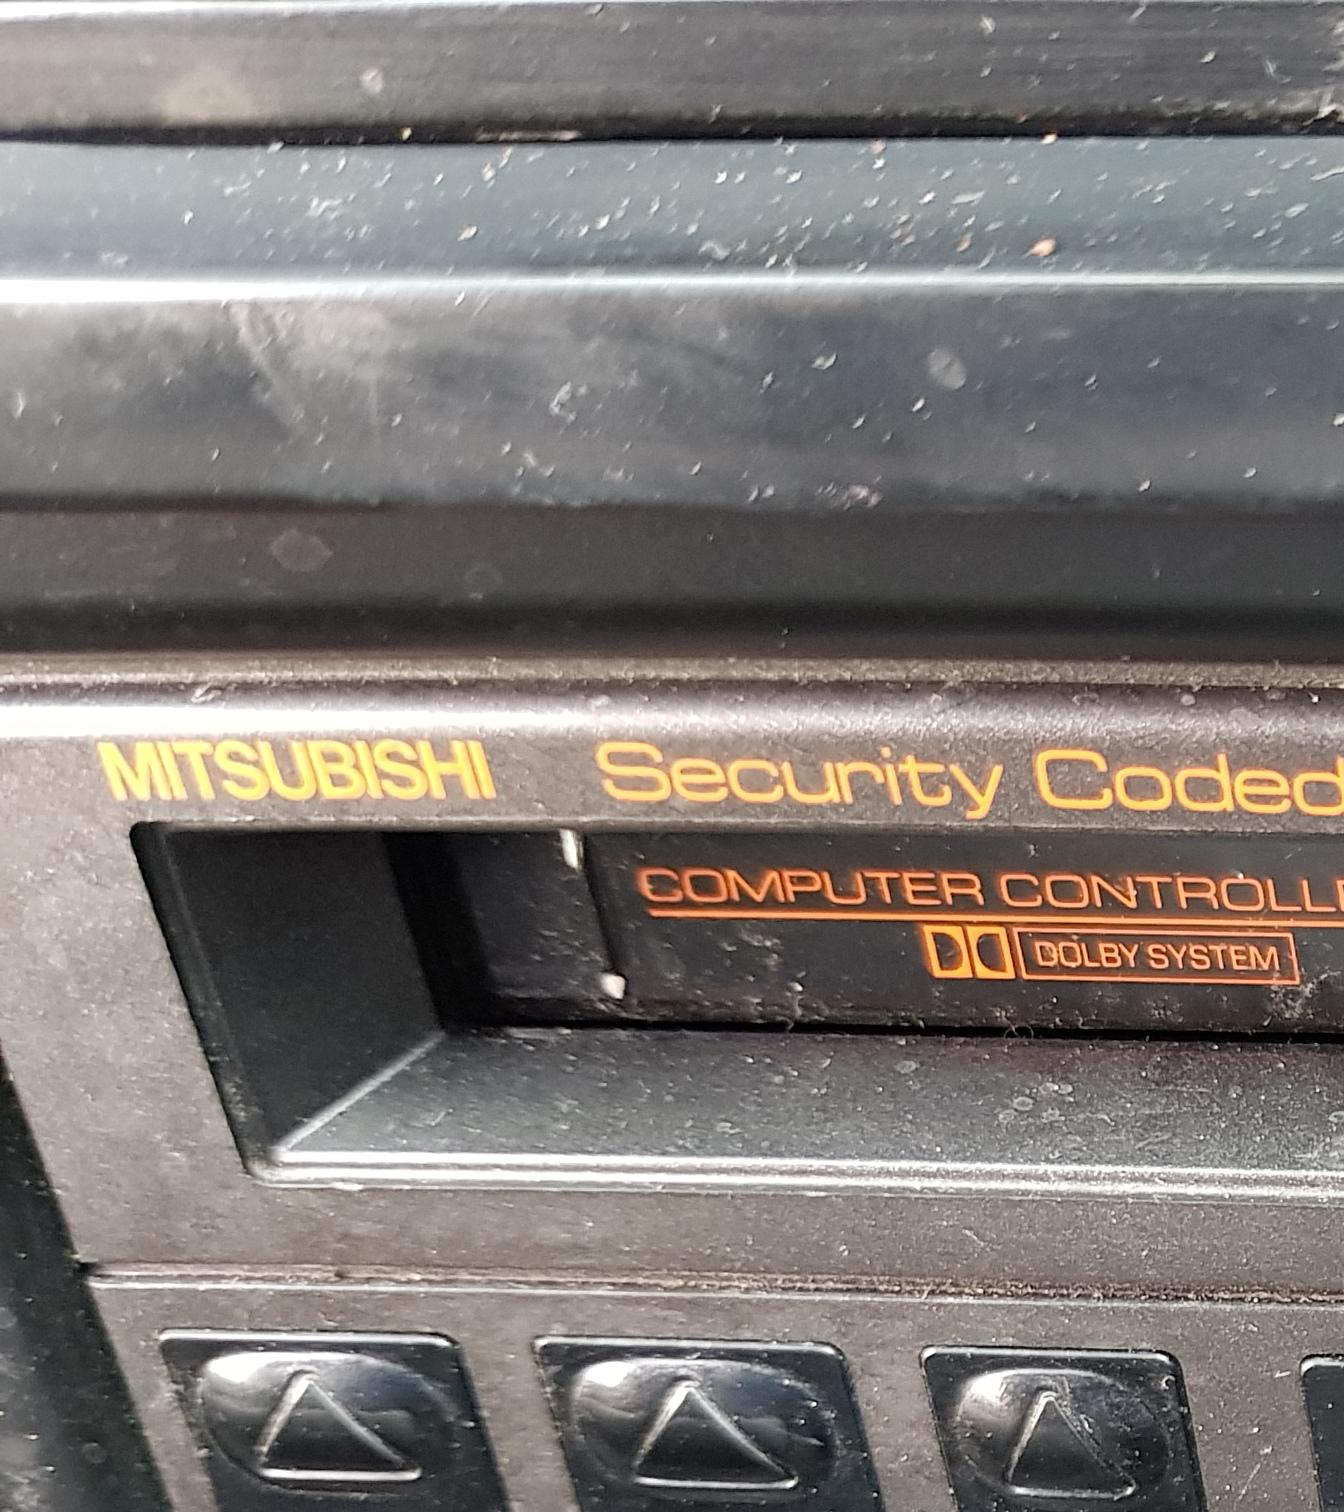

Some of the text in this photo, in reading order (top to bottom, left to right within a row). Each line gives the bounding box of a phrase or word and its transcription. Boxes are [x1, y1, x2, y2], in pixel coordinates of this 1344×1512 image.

[98, 739, 496, 802] MITSUBISHI
[595, 738, 1002, 822] Security
[638, 864, 986, 910] COMPUTER
[1032, 936, 1282, 974] DOLBY SYSTEM
